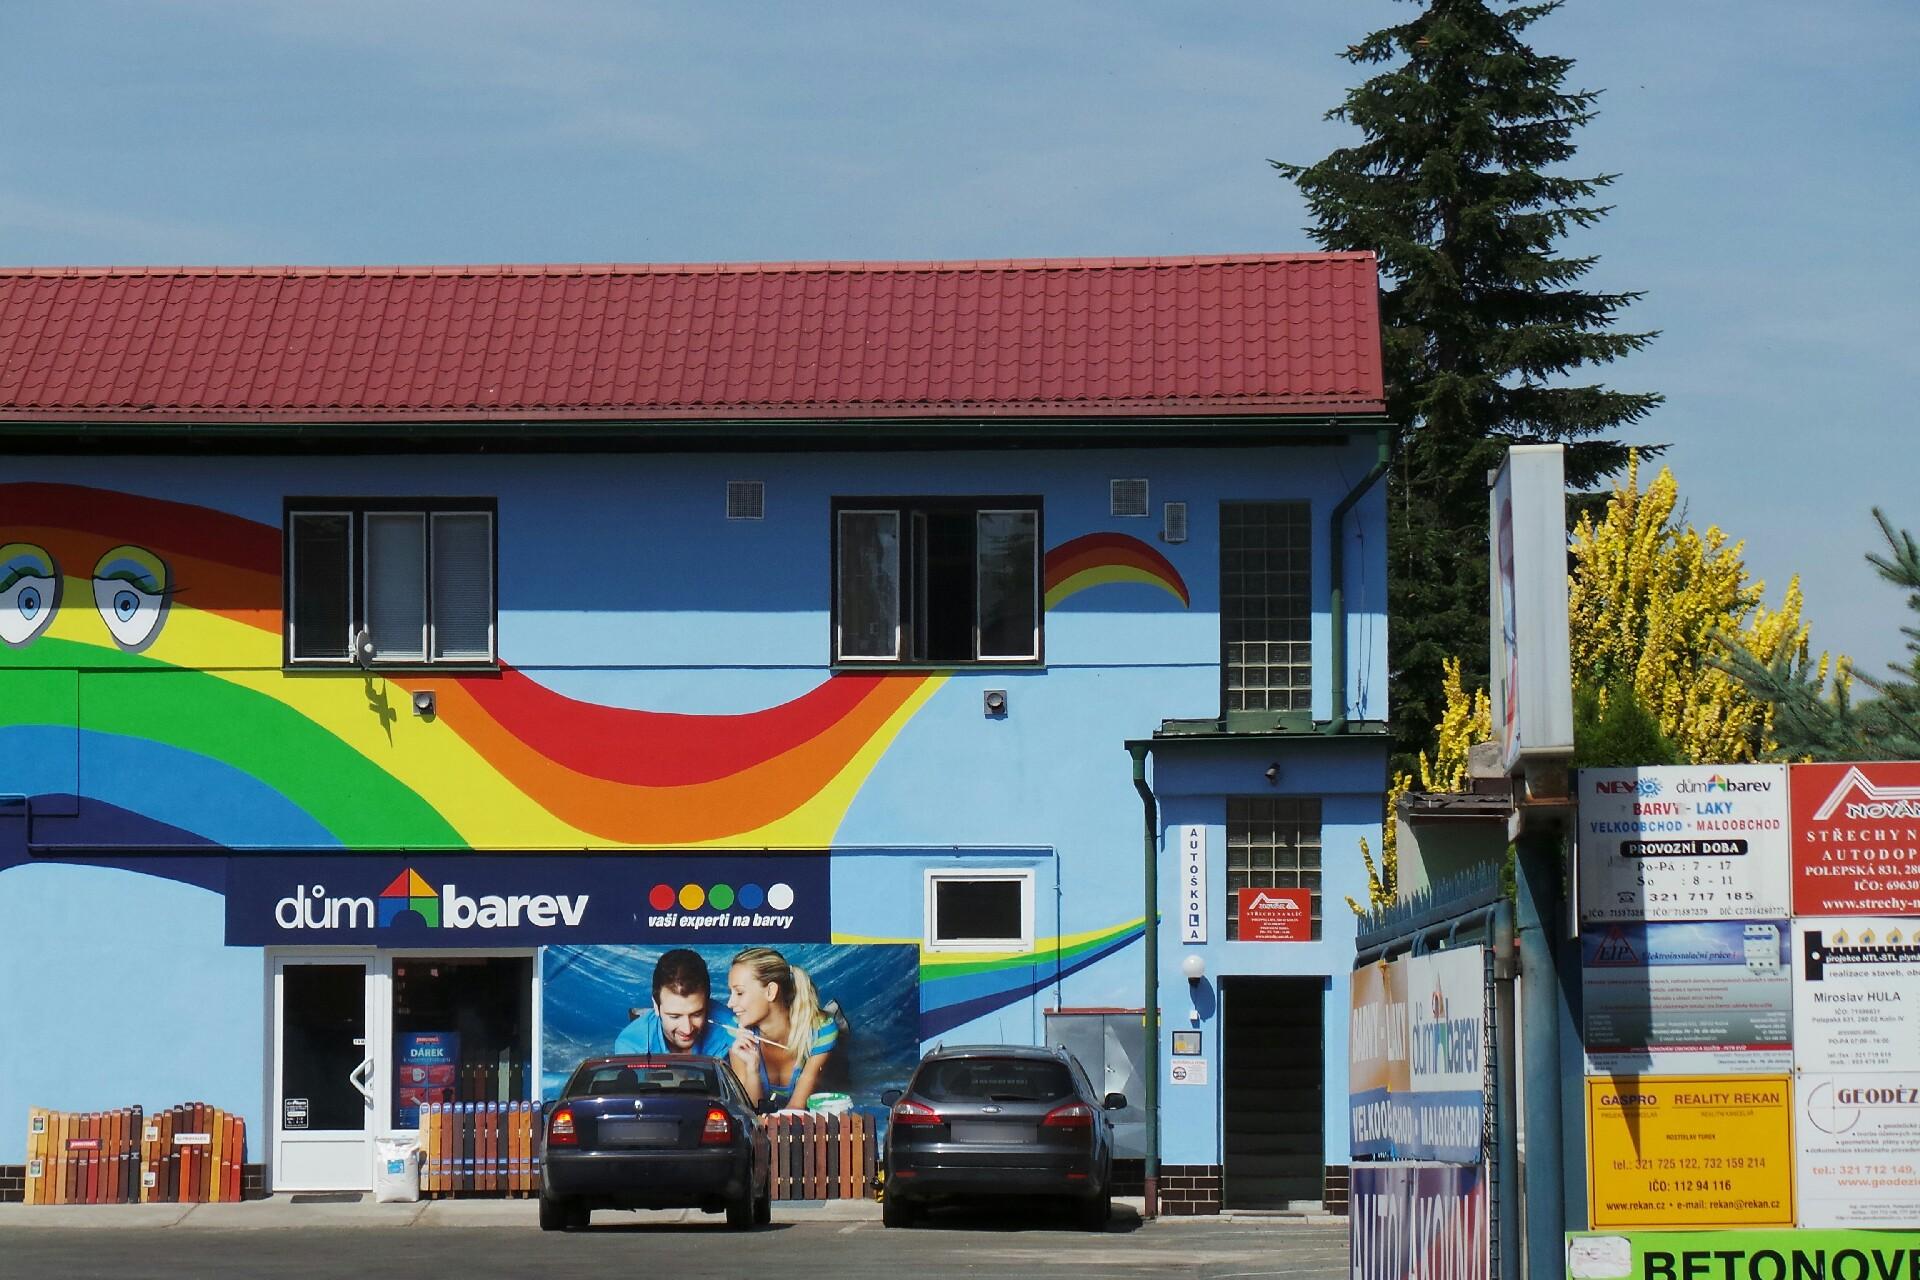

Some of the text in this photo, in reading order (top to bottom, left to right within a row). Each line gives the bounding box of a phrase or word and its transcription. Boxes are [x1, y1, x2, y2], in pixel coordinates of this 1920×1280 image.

[1676, 778, 1771, 793] dům barev
[1633, 802, 1680, 815] BARVY
[1696, 802, 1733, 814] LAKY
[1590, 821, 1682, 833] VELKOOBCHOD
[1696, 819, 1780, 831] MALOOBCHOD
[1806, 828, 1900, 842] STŘECHY
[1629, 841, 1739, 854] PROVOZNÍ DOBA
[1822, 849, 1918, 861] AUTODOP
[1692, 861, 1700, 871] 7
[1719, 861, 1731, 871] 17
[1805, 863, 1875, 876] POLEPSKÁ
[1637, 876, 1654, 887] So
[1692, 876, 1700, 886] 8
[1721, 876, 1733, 885] 11
[1854, 878, 1884, 891] IČO:
[1649, 892, 1754, 901] 321 717 185
[275, 884, 590, 928] dům barev
[648, 912, 794, 930] vaši experti na barvy
[1825, 953, 1861, 964] projekce
[1814, 991, 1901, 1002] Miroslav HULA
[1412, 997, 1480, 1076] dům barev
[410, 1047, 444, 1057] DÁREK
[1601, 1093, 1780, 1106] GASPRO REALITY REKAN
[1420, 1106, 1479, 1148] MALOOBCHOD
[1635, 1159, 1653, 1170] 321
[1657, 1159, 1675, 1169] 725
[1704, 1159, 1722, 1169] 732
[1727, 1158, 1744, 1168] 159
[1747, 1158, 1766, 1168] 214
[1839, 1166, 1861, 1175] 321
[1865, 1166, 1887, 1175] 712
[1649, 1179, 1731, 1192] IČO: 112 94 116
[1606, 1201, 1665, 1211] www.rekan.cz
[1709, 1199, 1780, 1211] rekan@rekan.cz
